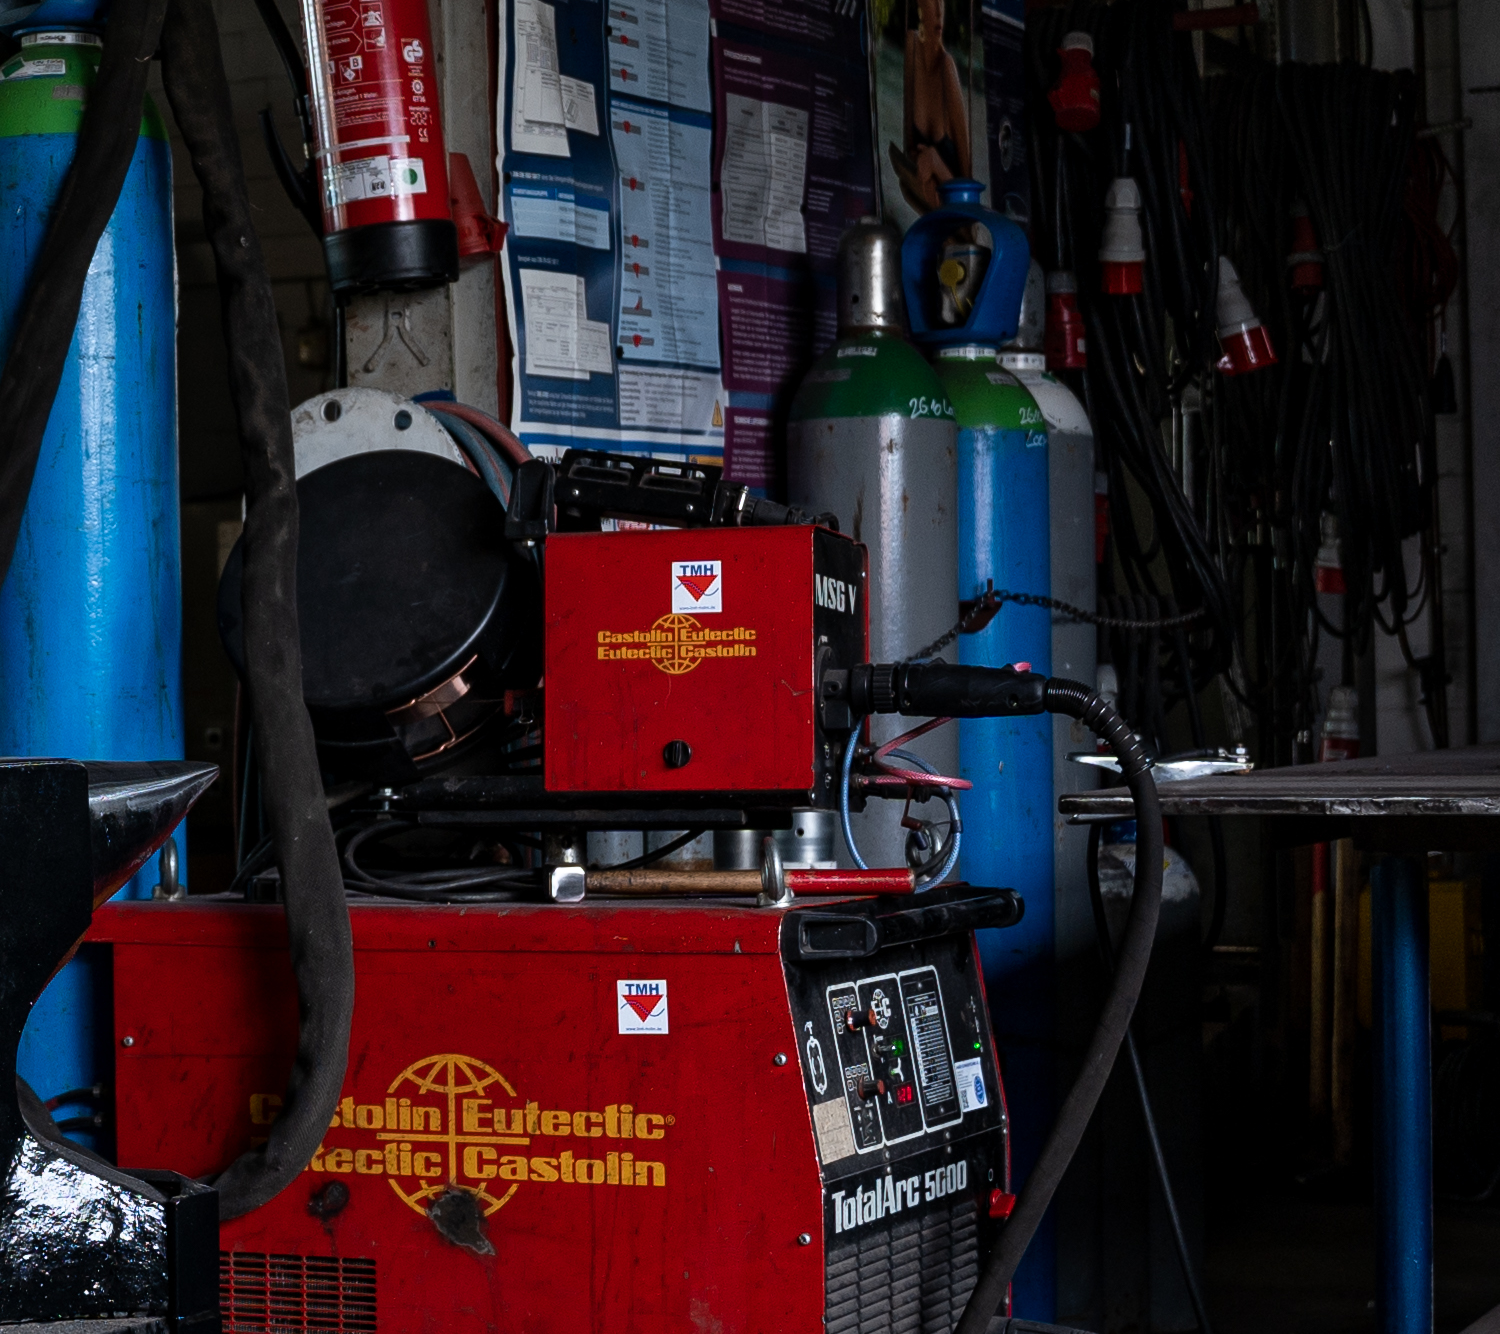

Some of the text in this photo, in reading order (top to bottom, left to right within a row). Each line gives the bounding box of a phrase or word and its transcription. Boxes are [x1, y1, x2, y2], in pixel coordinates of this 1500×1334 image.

[353, 58, 359, 67] B
[679, 564, 714, 576] TMH
[815, 573, 858, 615] MSG V
[597, 627, 757, 644] Castolin Eutectic
[597, 645, 757, 661] Eutectic Castolin
[625, 983, 660, 995] TMH
[463, 1146, 667, 1188] Castolin
[831, 1160, 967, 1234] TotalArc 5000
